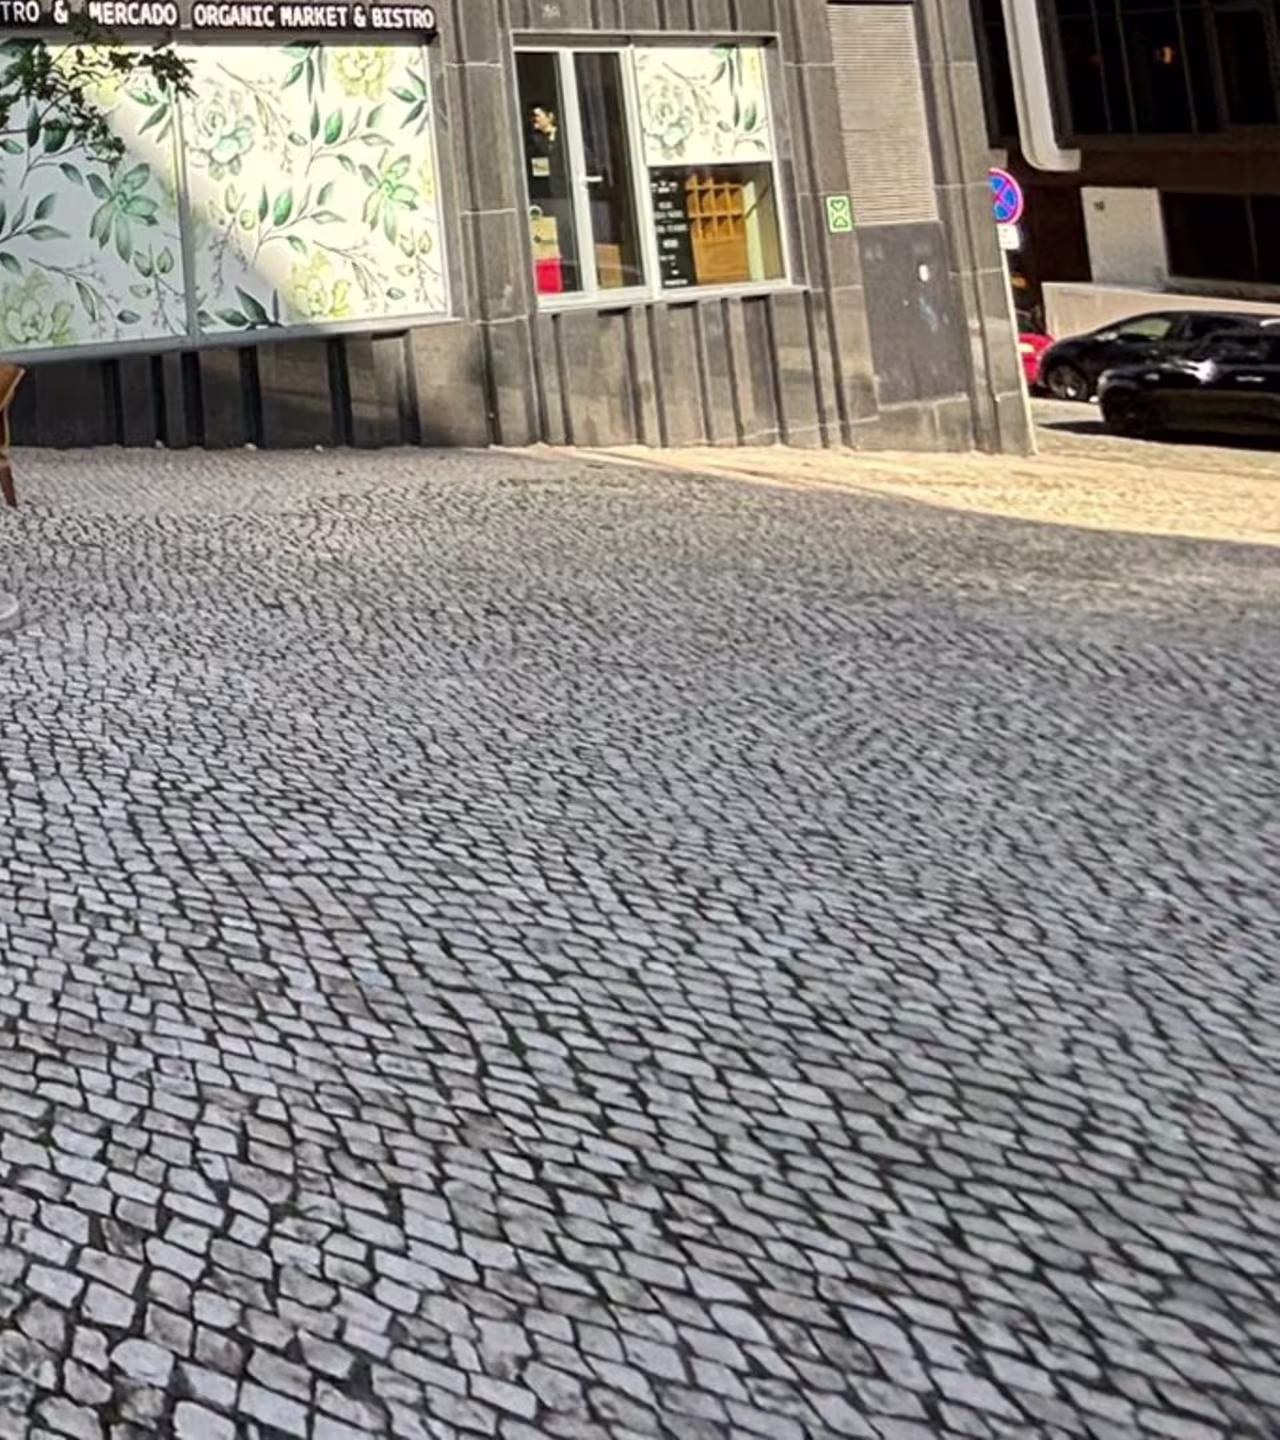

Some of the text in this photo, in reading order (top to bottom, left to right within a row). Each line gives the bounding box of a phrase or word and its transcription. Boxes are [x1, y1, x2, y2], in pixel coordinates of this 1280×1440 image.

[89, 2, 179, 26] MERCADO
[193, 4, 275, 28] ORGANIC
[280, 5, 348, 28] MARKET
[353, 6, 367, 28] &
[371, 7, 435, 29] BISTRO
